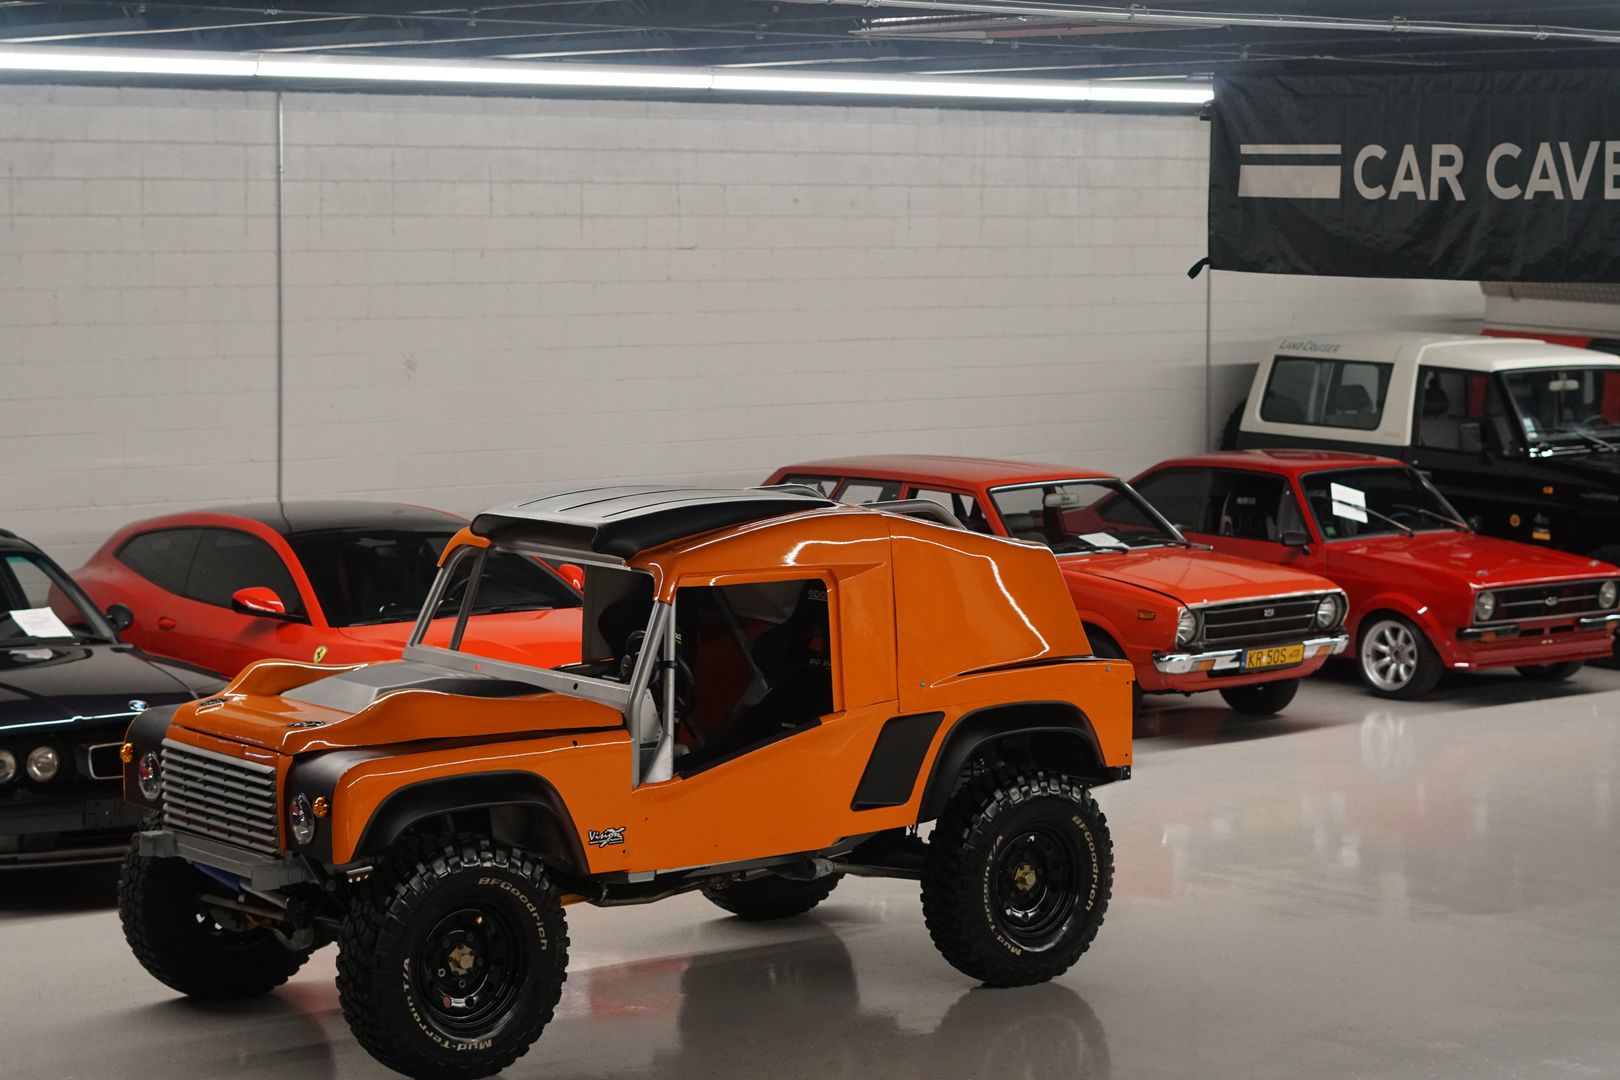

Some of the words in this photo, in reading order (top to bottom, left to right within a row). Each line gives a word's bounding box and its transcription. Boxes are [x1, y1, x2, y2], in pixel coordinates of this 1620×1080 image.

[1353, 143, 1466, 201] CAR
[1247, 651, 1264, 667] KR
[1072, 815, 1099, 911] BFGoodrich
[478, 877, 548, 950] BFGoodrich
